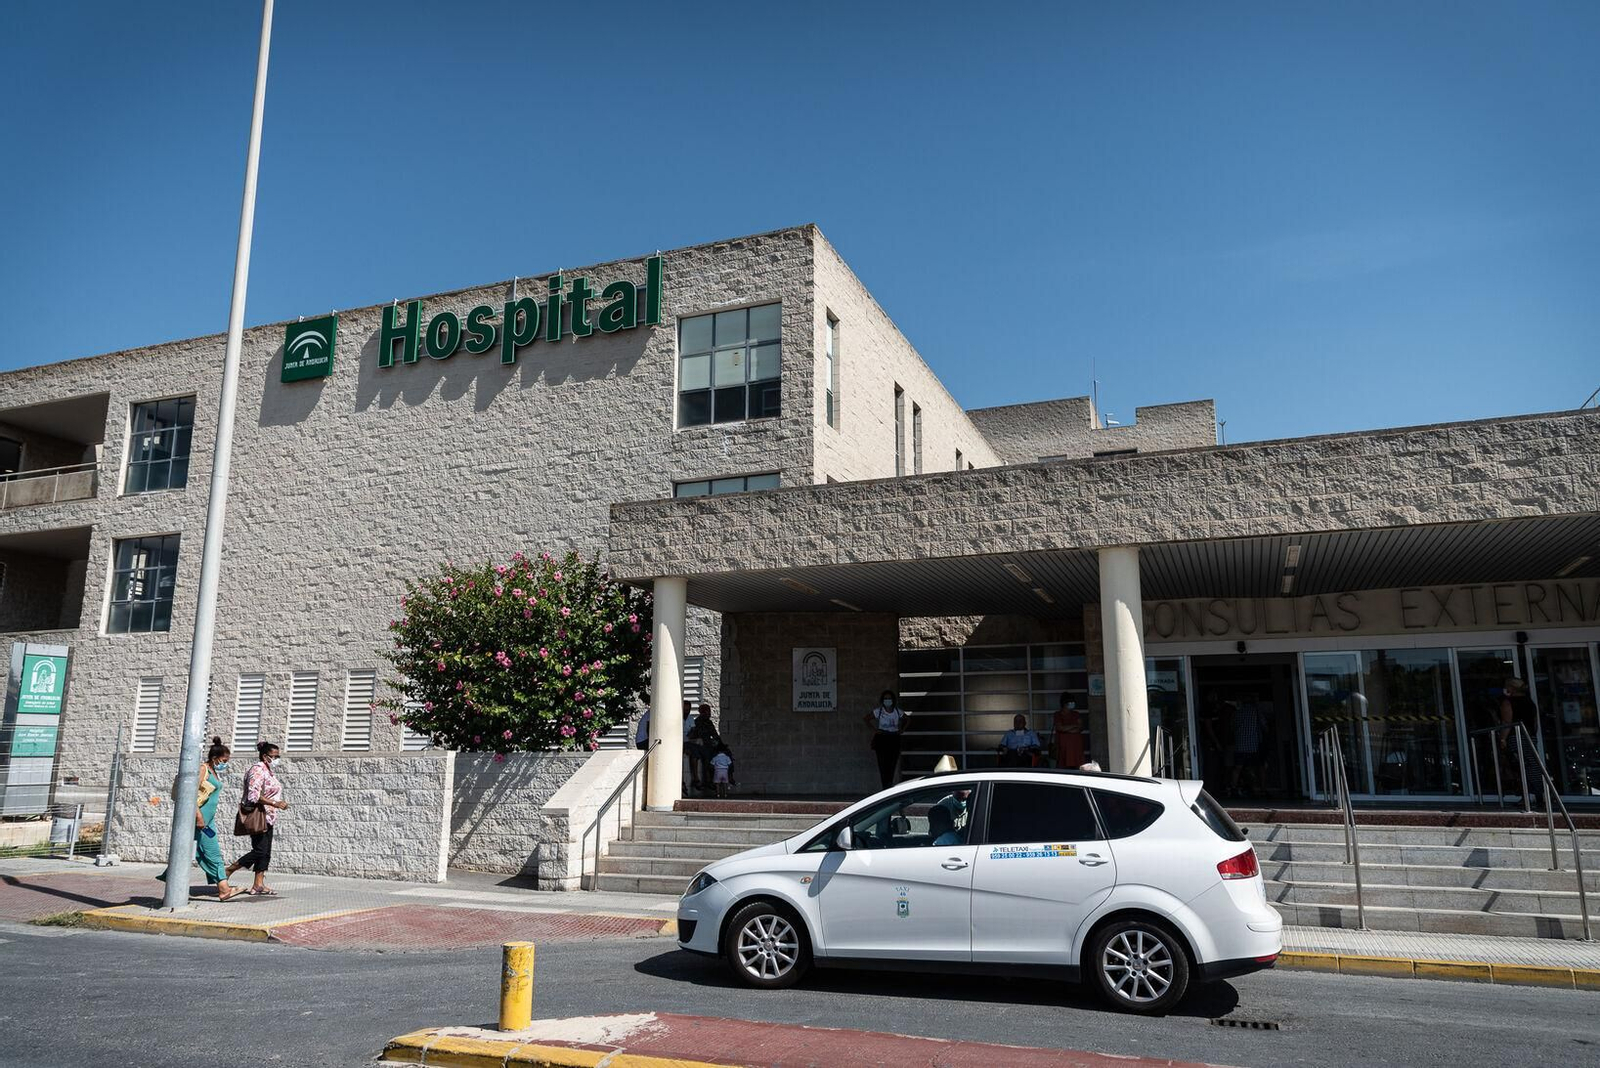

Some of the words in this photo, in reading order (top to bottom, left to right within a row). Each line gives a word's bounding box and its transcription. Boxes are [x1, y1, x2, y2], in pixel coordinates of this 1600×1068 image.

[377, 254, 663, 369] Hospital
[285, 361, 298, 369] JUNTA
[799, 691, 820, 699] JUNTA
[822, 691, 831, 699] DE
[797, 700, 833, 708] ANDALUCIA
